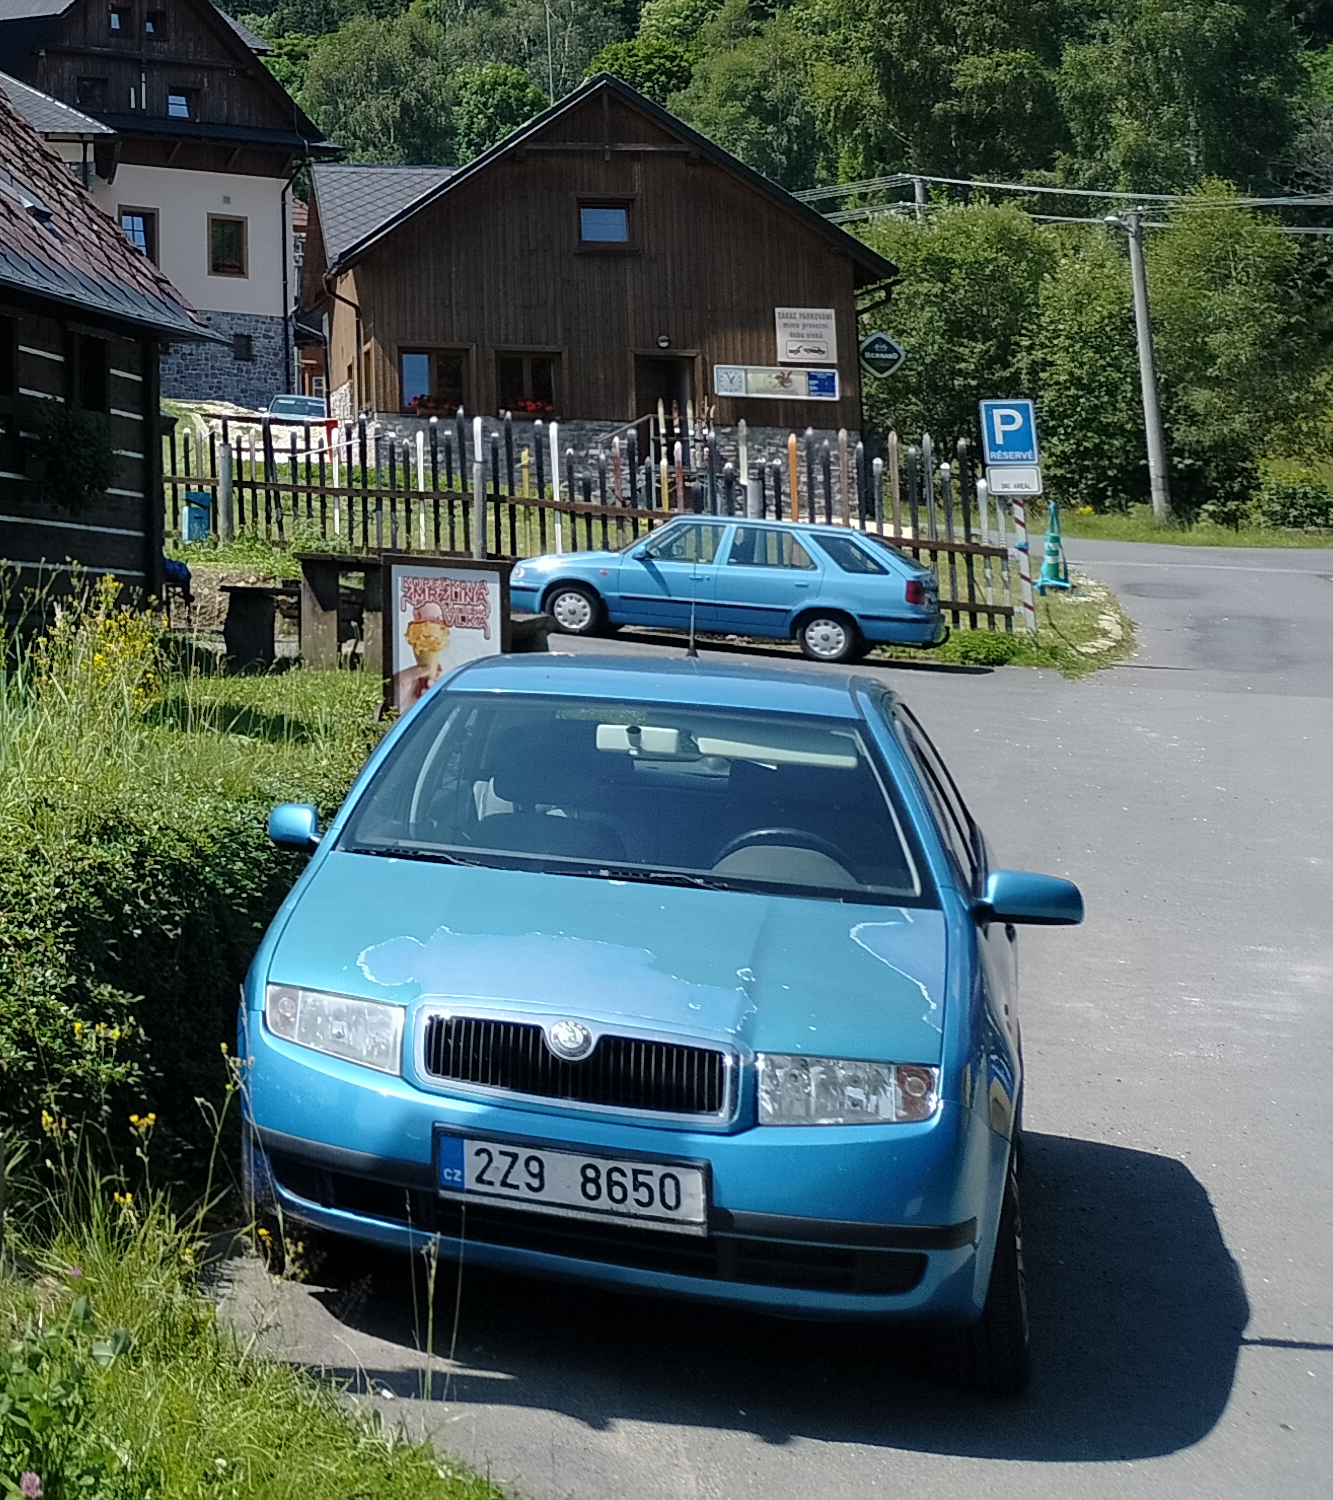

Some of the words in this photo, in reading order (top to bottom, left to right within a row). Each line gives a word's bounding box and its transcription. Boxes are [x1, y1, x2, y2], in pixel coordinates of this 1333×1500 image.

[993, 408, 1023, 445] P
[990, 449, 1033, 460] RÉSERVÉ
[402, 586, 489, 603] ZMRZLINA
[443, 1167, 463, 1182] CZ
[474, 1147, 545, 1193] 2Z9
[580, 1163, 681, 1211] 8650
